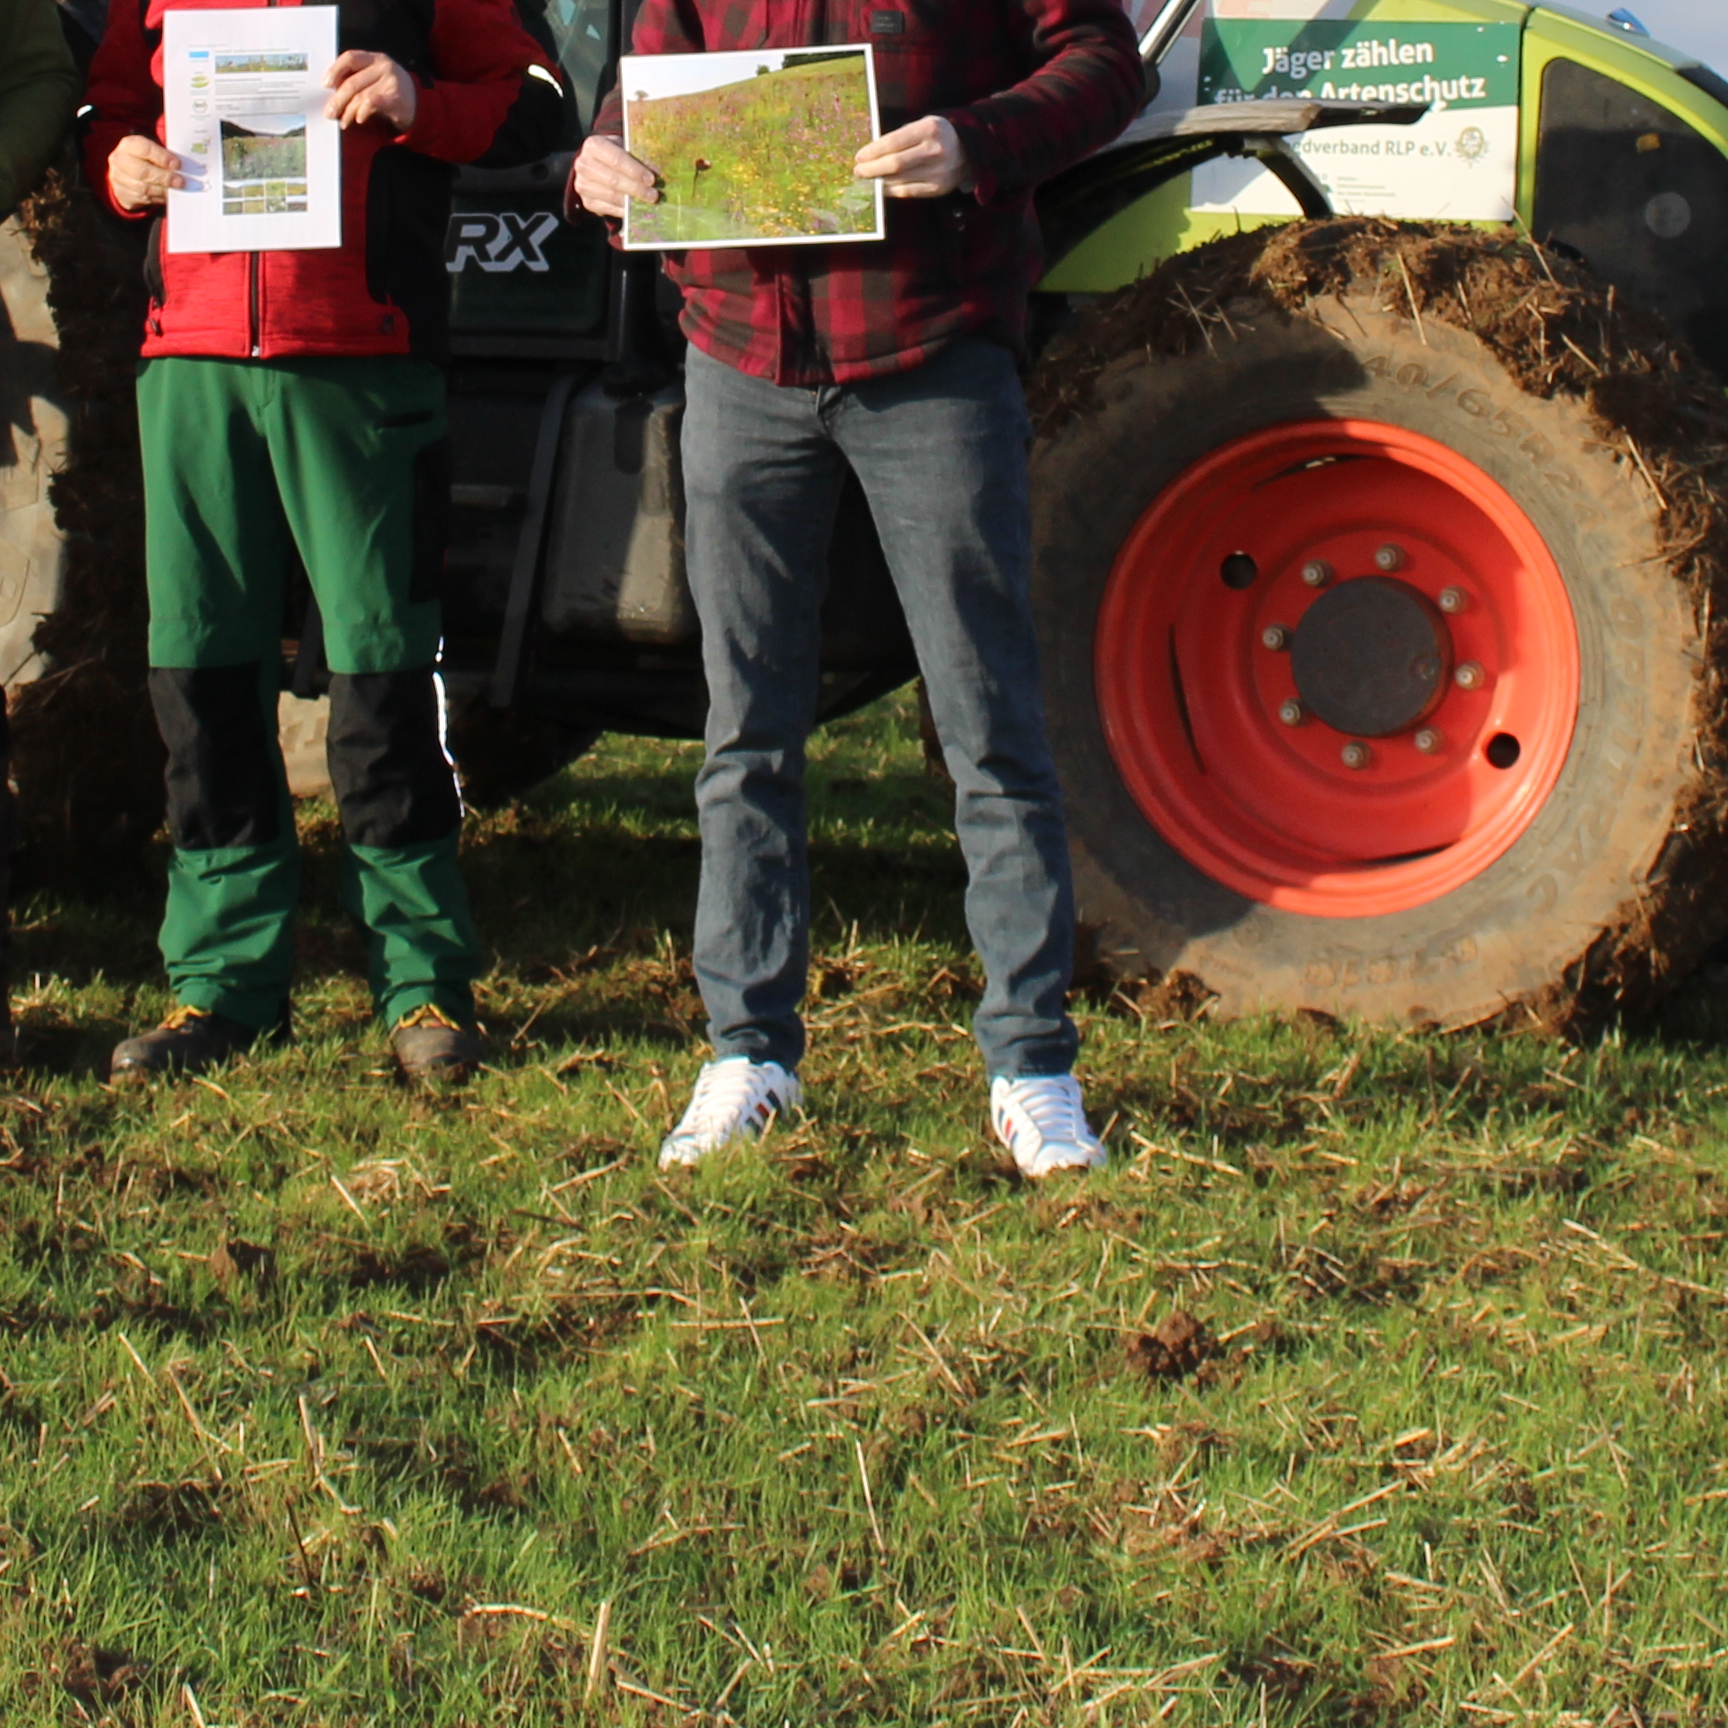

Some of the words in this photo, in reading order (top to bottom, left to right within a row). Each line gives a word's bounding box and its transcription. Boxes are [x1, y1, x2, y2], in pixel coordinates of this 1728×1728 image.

[1262, 46, 1335, 79] Jäger
[1341, 38, 1434, 69] zählen
[1321, 74, 1487, 104] Artenschutz
[1385, 141, 1415, 156] RLP
[1420, 141, 1452, 157] e.V.
[444, 212, 559, 272] RX
